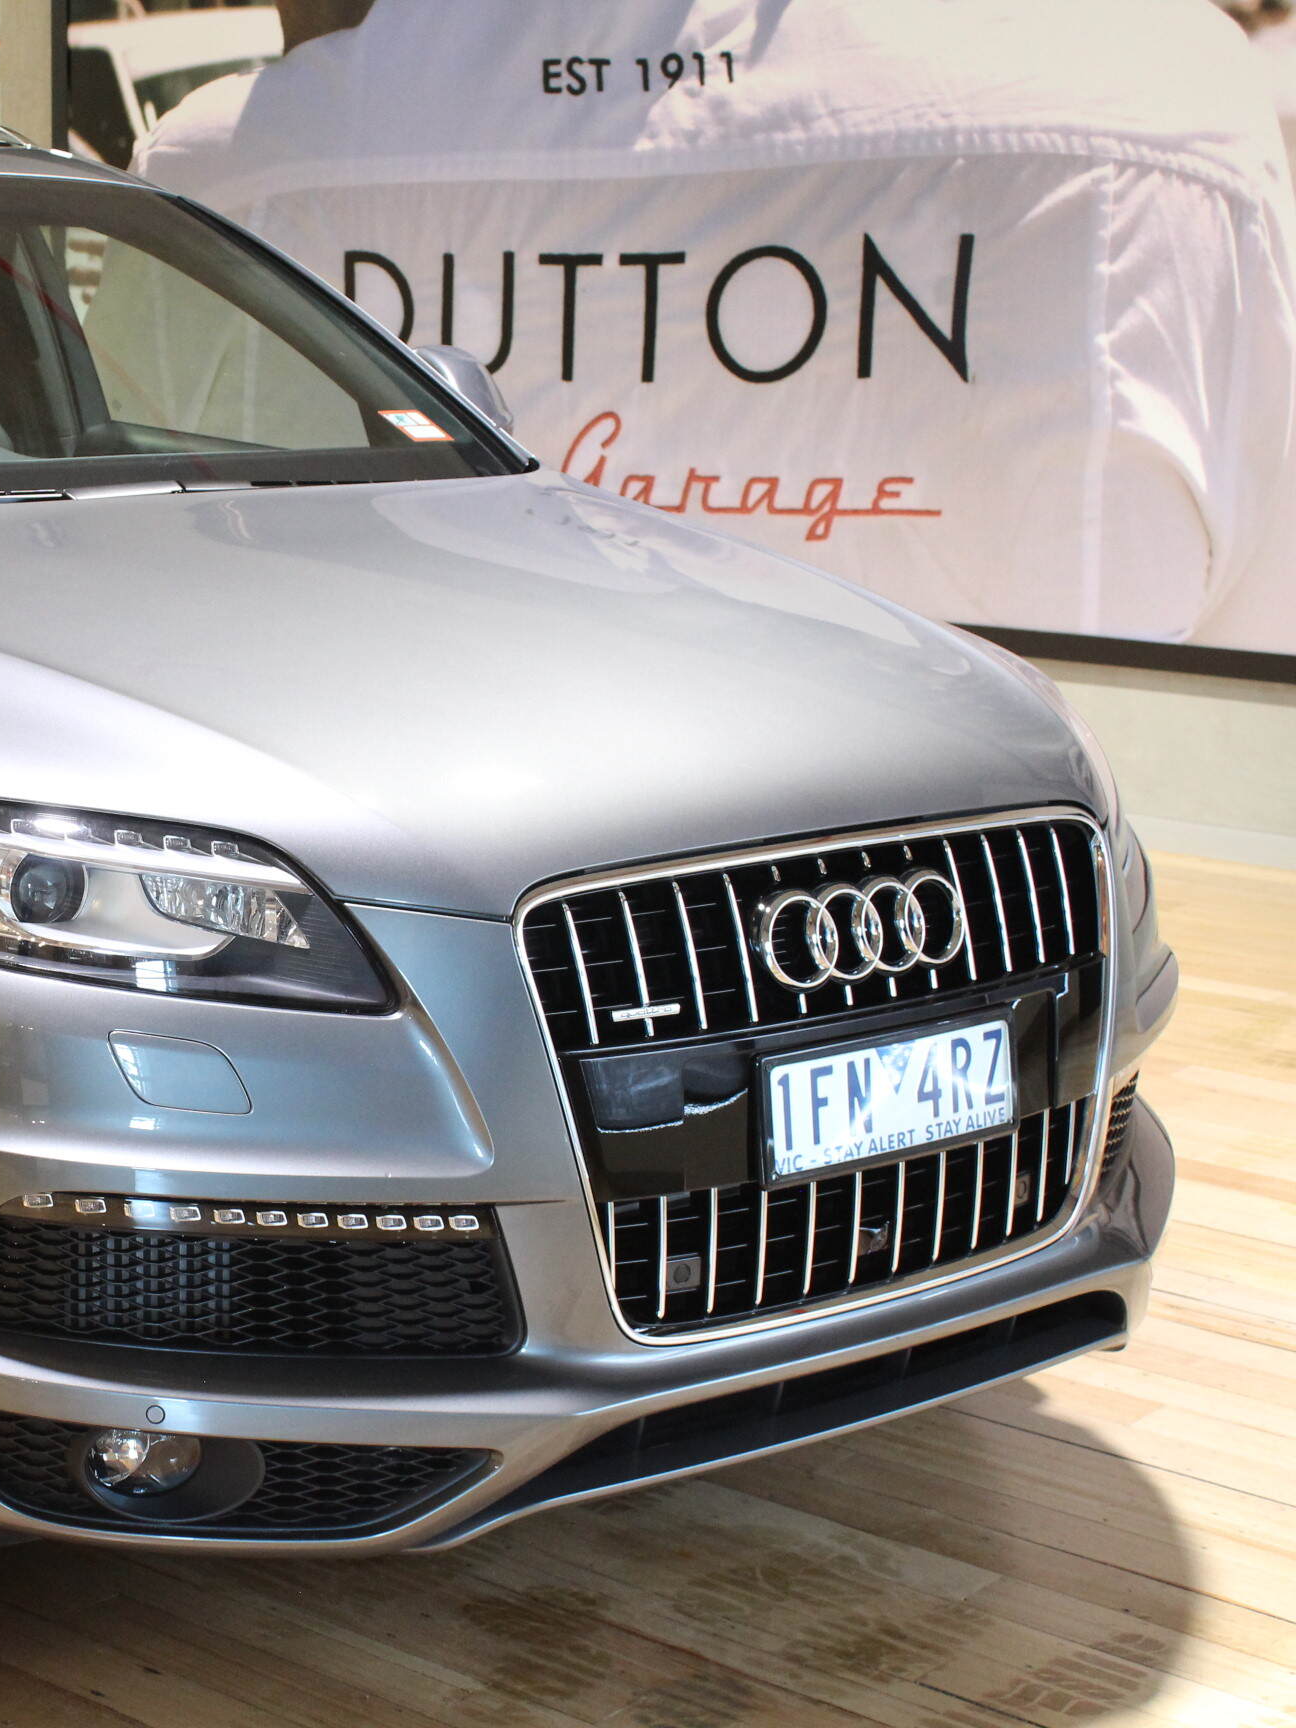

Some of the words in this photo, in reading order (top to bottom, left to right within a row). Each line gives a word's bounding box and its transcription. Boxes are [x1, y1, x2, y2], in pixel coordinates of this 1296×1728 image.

[542, 56, 611, 96] EST
[635, 51, 735, 92] 1911
[342, 232, 976, 384] DUTTON
[776, 1057, 873, 1152] 1FN
[916, 1027, 1005, 1119] 4RZ
[775, 1154, 804, 1175] VIC
[824, 1141, 864, 1165] STAY
[868, 1129, 916, 1155] ALERT
[925, 1117, 962, 1142] STAY
[965, 1106, 1006, 1131] ALIVE
